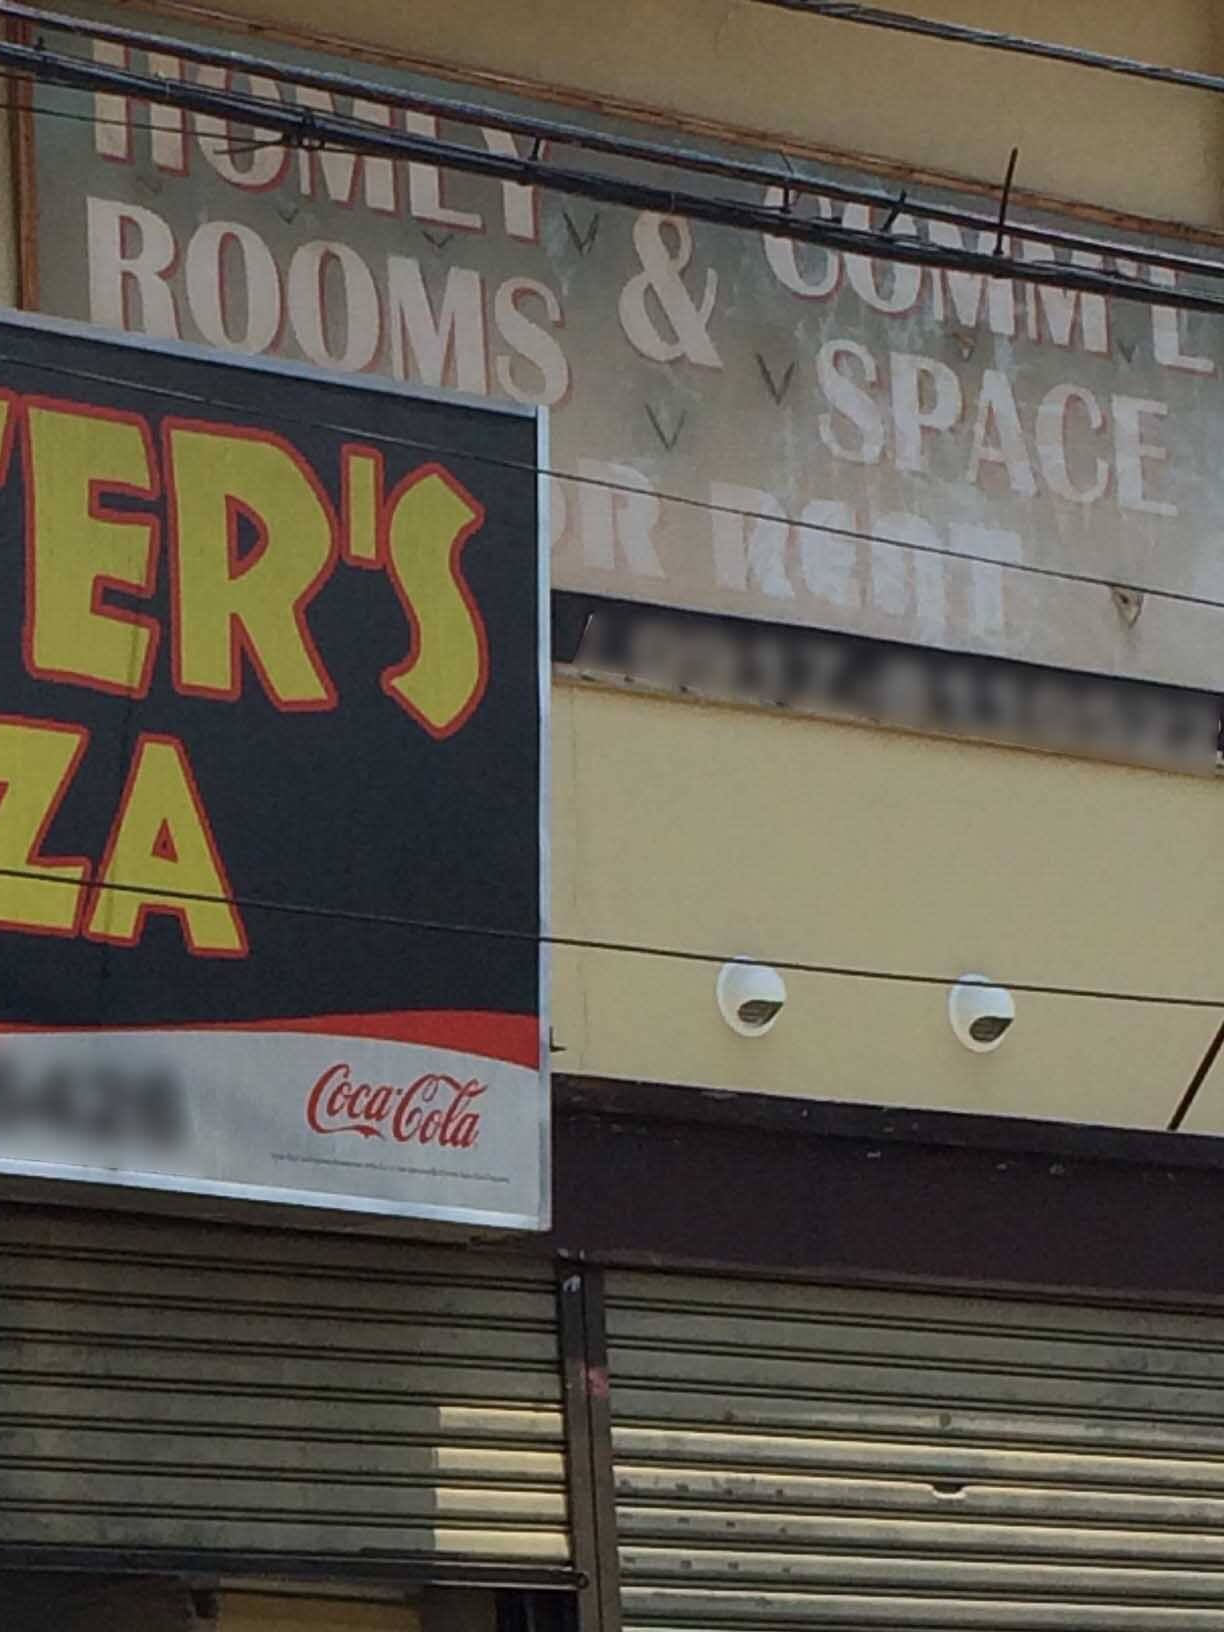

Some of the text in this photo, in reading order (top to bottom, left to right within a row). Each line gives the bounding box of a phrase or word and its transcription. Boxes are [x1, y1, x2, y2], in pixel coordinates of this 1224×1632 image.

[86, 196, 723, 405] ROOMS &
[815, 338, 1178, 517] SPACE
[307, 1063, 488, 1149] Coca-Cola
